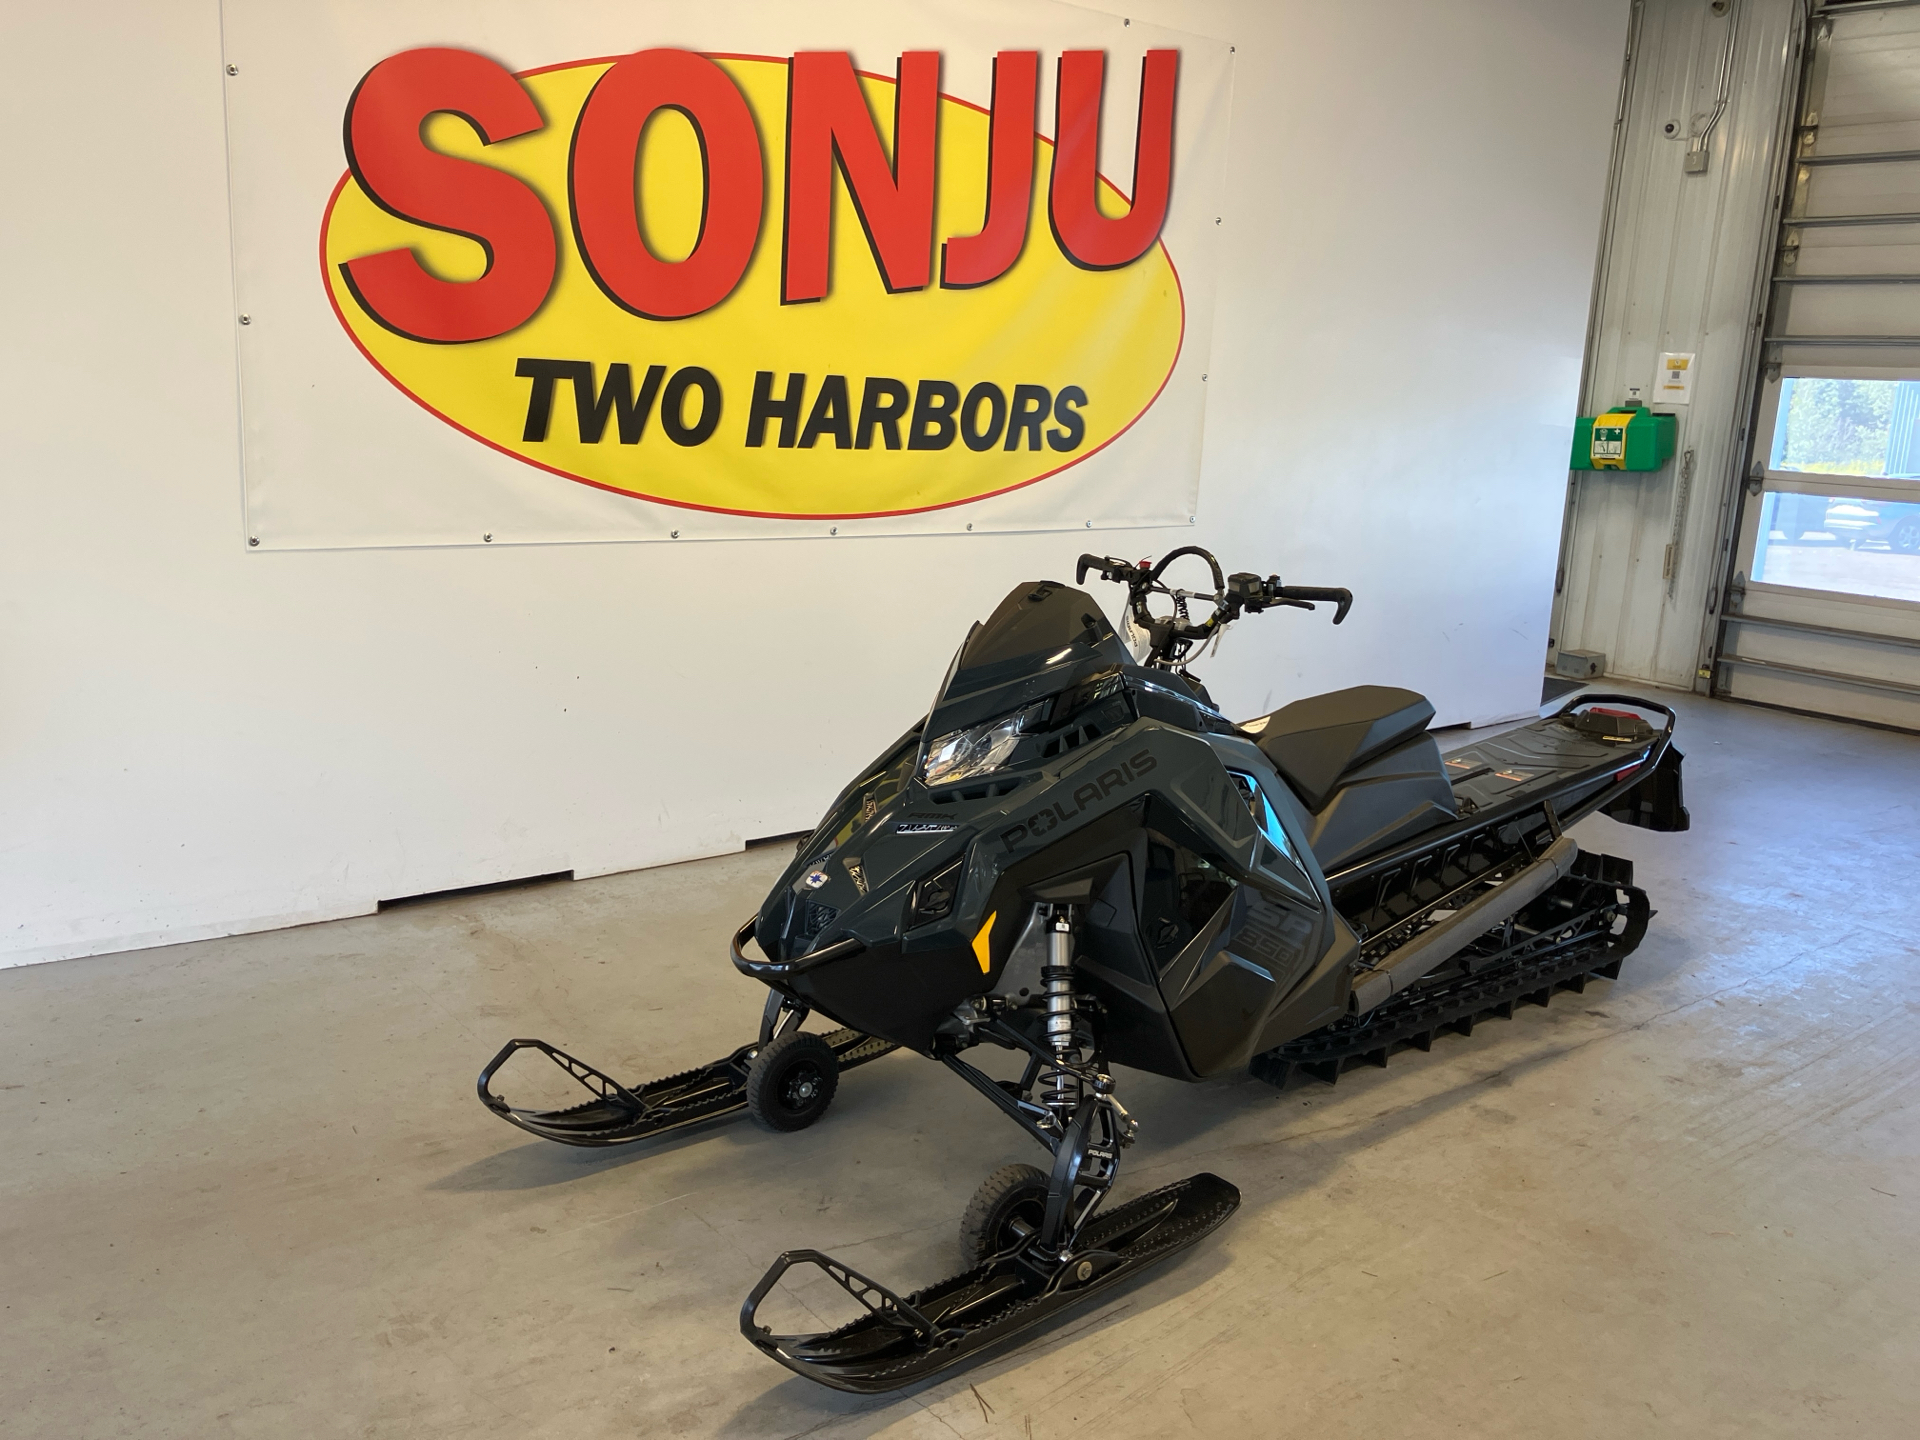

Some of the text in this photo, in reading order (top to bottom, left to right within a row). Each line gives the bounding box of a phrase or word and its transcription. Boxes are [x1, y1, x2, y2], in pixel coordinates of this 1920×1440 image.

[338, 47, 1179, 343] SONJU
[514, 357, 1089, 453] TWO HARBORS
[1000, 749, 1157, 853] POLARIS
[1234, 926, 1295, 967] 850
[1088, 1149, 1113, 1159] POLARIS
